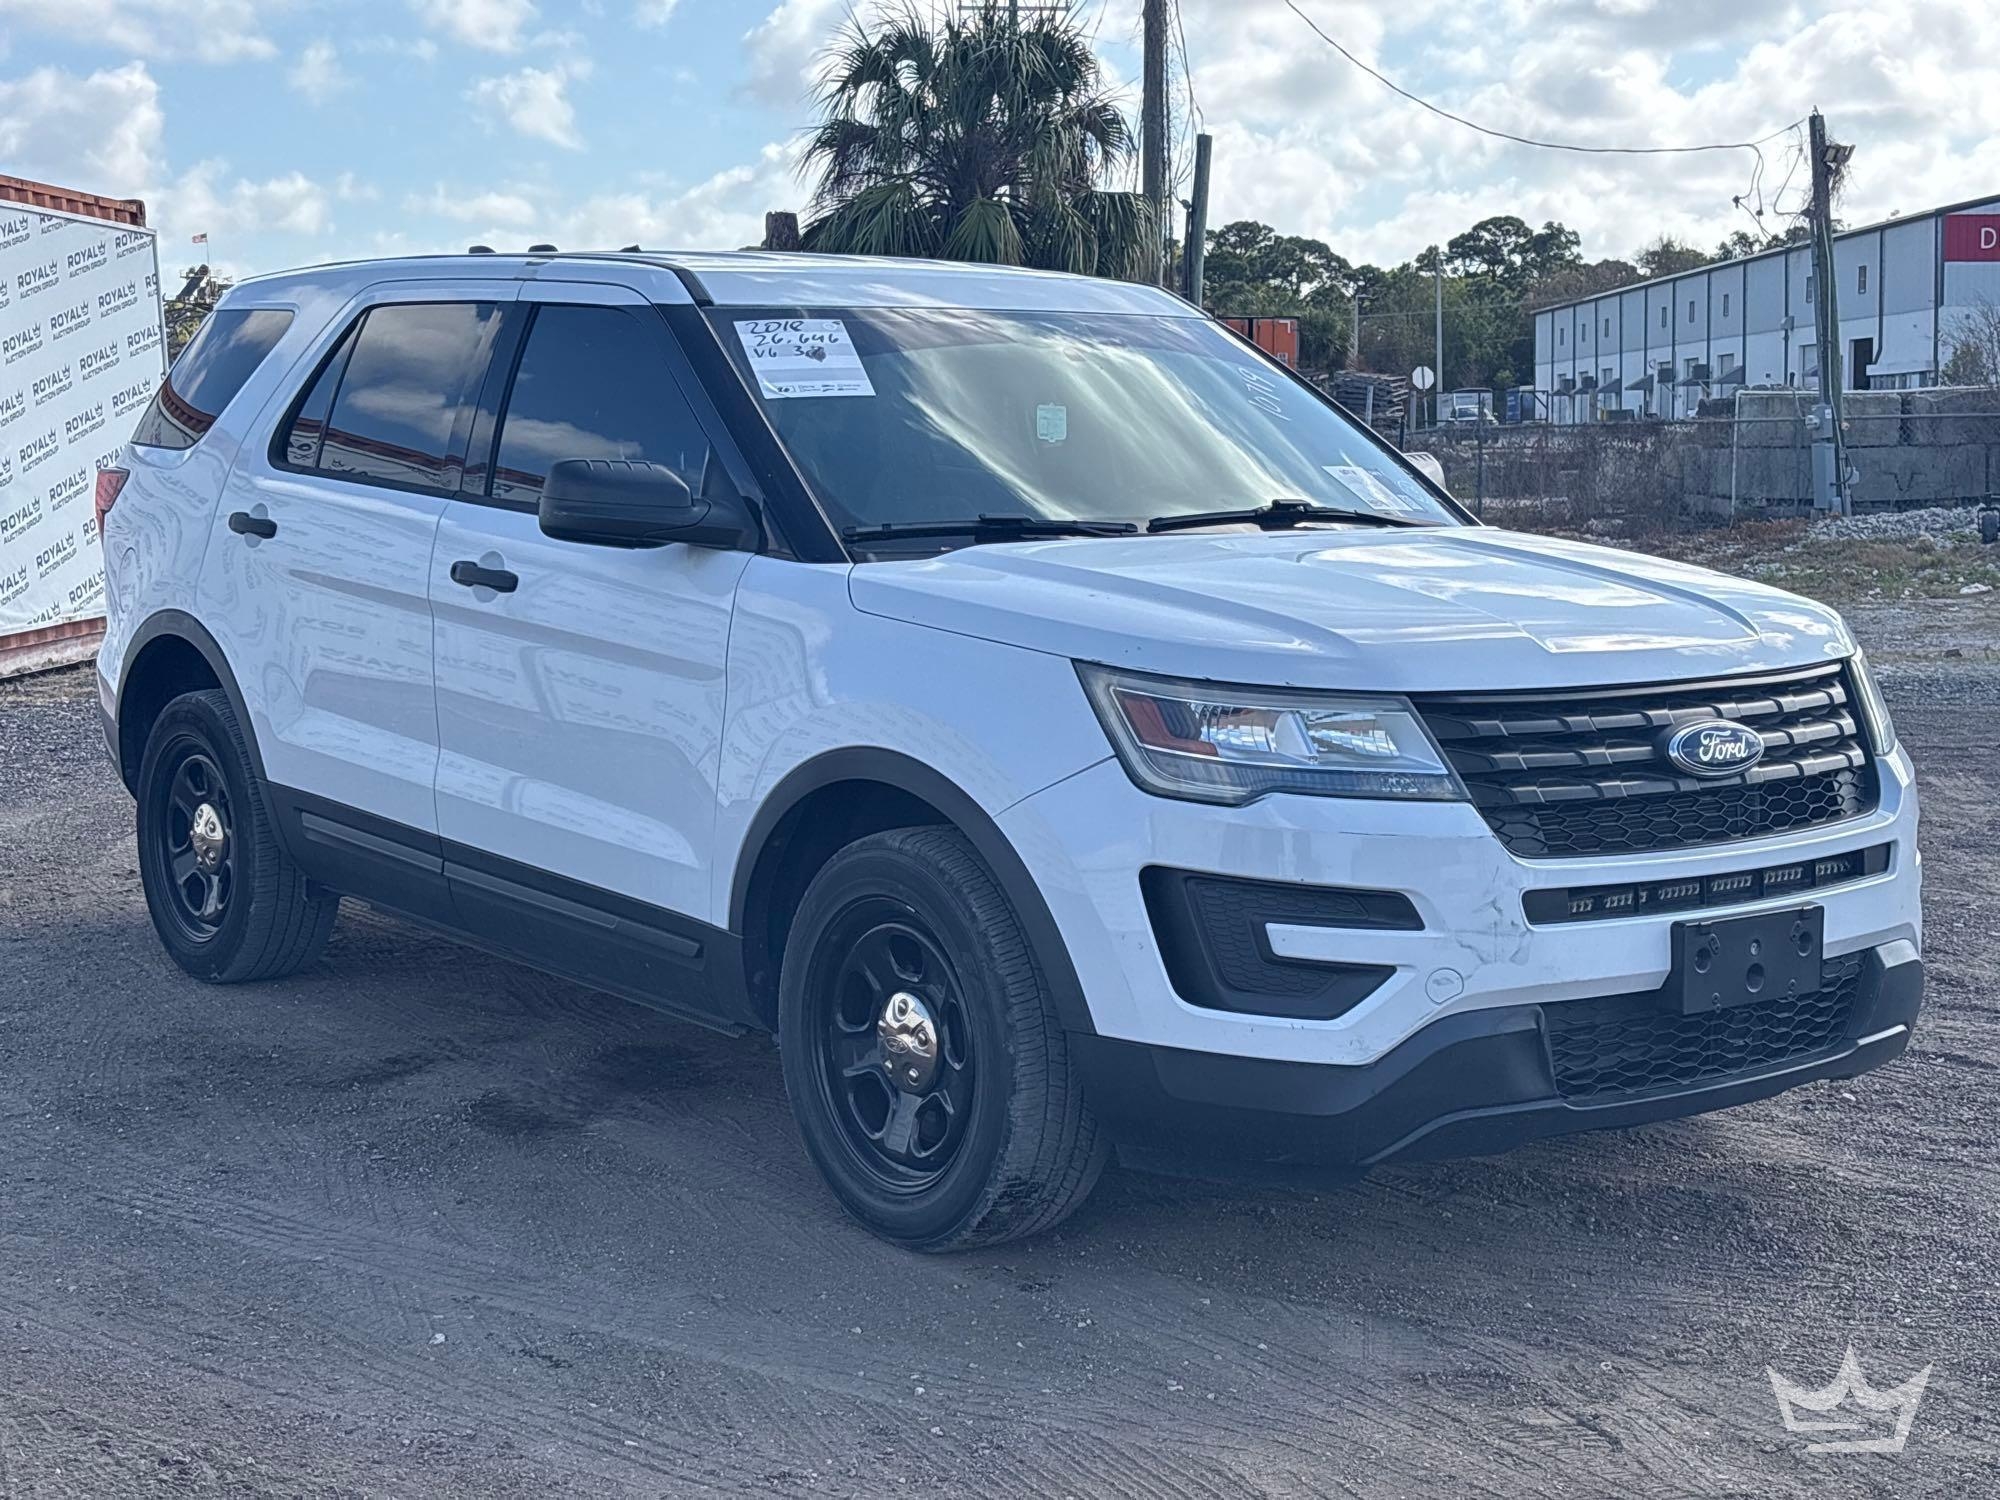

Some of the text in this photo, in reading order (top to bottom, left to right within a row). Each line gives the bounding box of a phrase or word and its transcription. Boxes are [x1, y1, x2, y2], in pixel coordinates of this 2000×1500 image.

[68, 246, 98, 268] ROYAL
[116, 247, 136, 259] AUCTION
[18, 265, 50, 289] ROYAL
[70, 258, 107, 278] AUCTION GROUP
[20, 277, 59, 298] AUCTION GROUP
[98, 286, 128, 308] ROYAL
[50, 306, 81, 330] ROYAL
[100, 296, 138, 318] AUCTION GROUP
[53, 318, 90, 340] AUCTION GROUP
[127, 325, 158, 348] ROYAL
[2, 329, 33, 354] ROYAL
[6, 340, 43, 364] AUCTION GROUP
[130, 343, 151, 358] AUCTION
[753, 346, 777, 358] V6
[80, 347, 110, 371] ROYAL
[82, 357, 120, 380] AUCTION GROUP
[32, 370, 63, 396] ROYAL
[36, 381, 72, 406] AUCTION GROUP
[112, 384, 144, 408] ROYAL
[115, 394, 152, 418] AUCTION GROUP
[65, 409, 96, 434] ROYAL
[68, 418, 106, 444] AUCTION GROUP
[20, 435, 50, 463] ROYAL
[22, 445, 59, 474] AUCTION GROUP
[50, 474, 80, 502] ROYAL
[52, 483, 89, 511] AUCTION GROUP
[0, 504, 33, 534] ROYAL
[4, 513, 42, 544] AUCTION GROUP
[36, 539, 67, 569] ROYAL
[40, 548, 76, 580] AUCTION GROUP
[12, 582, 30, 600] GROUP
[69, 574, 99, 604] ROYAL
[73, 595, 94, 614] AUCTION
[1700, 730, 1749, 762] Ford
